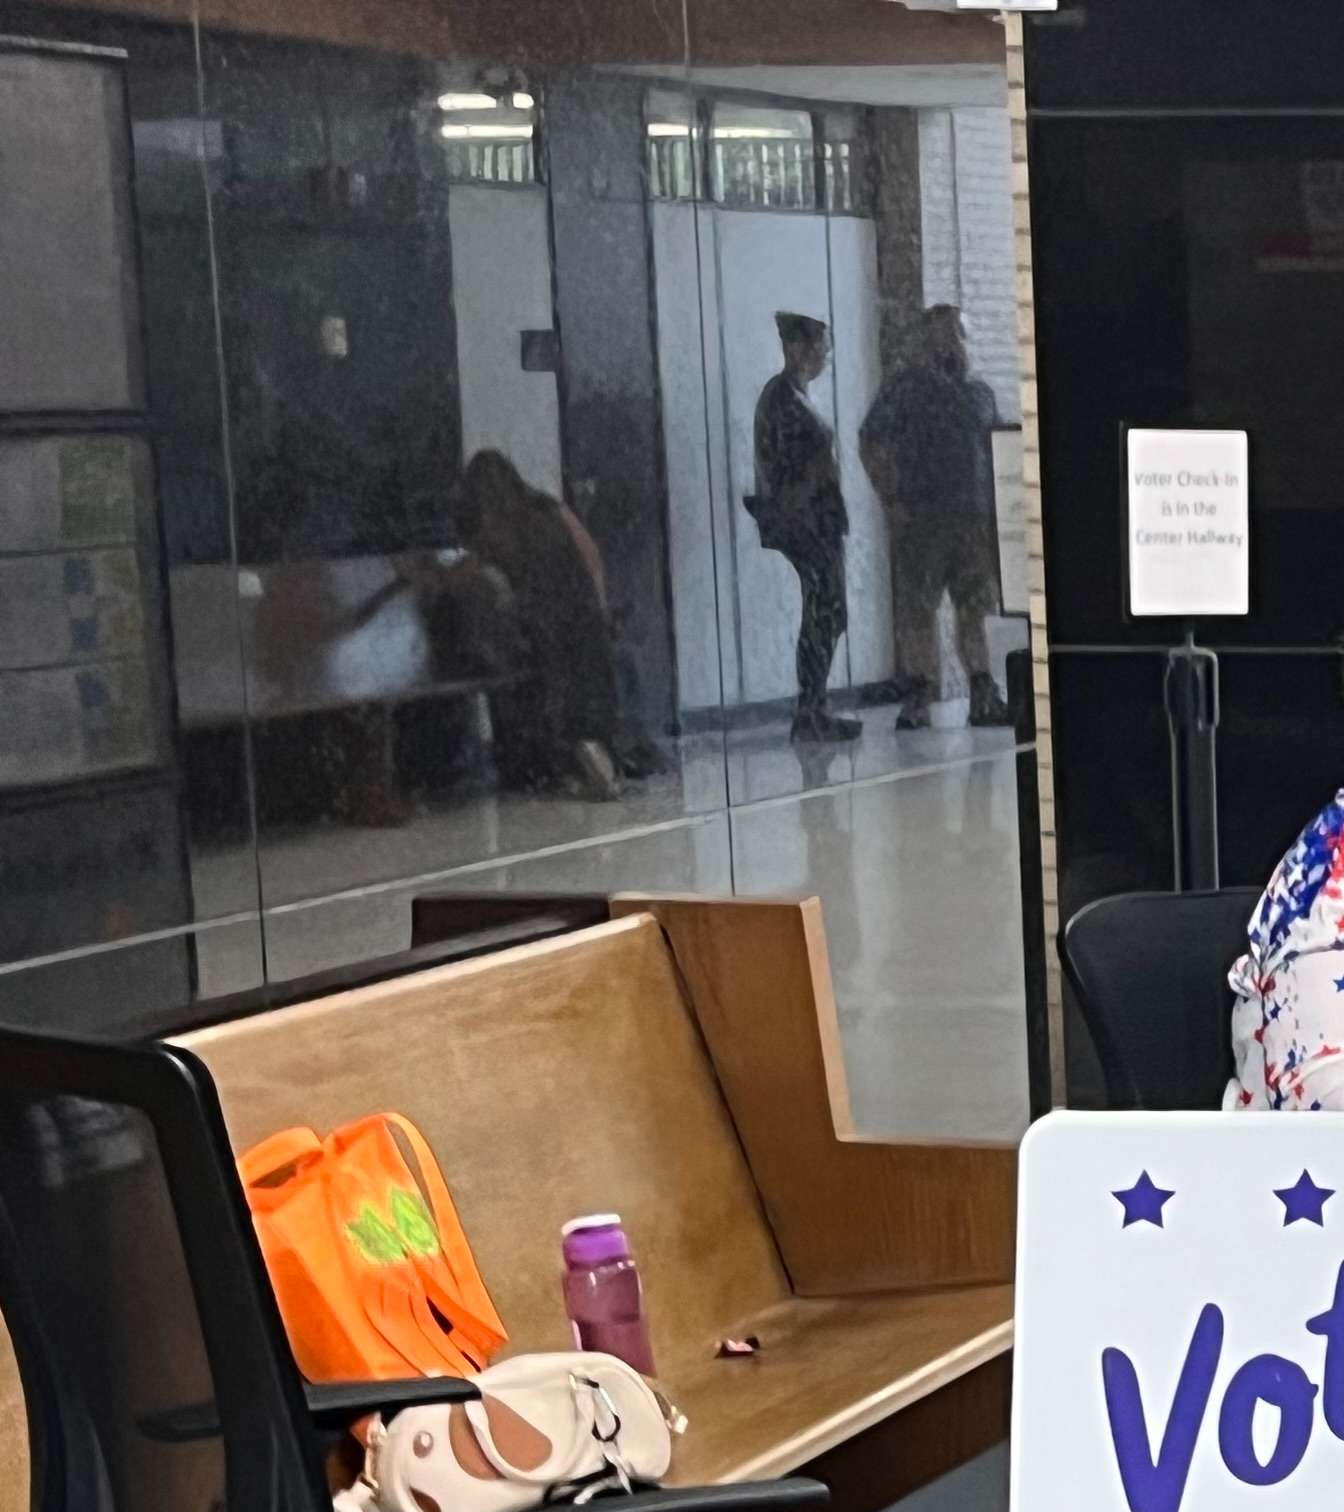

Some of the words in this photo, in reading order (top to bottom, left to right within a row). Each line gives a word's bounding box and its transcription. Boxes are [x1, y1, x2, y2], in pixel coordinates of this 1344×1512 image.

[1133, 471, 1173, 487] Voter
[1161, 501, 1173, 516] is
[1193, 501, 1217, 516] the
[1135, 529, 1183, 545] Center
[1187, 529, 1243, 548] Hallway
